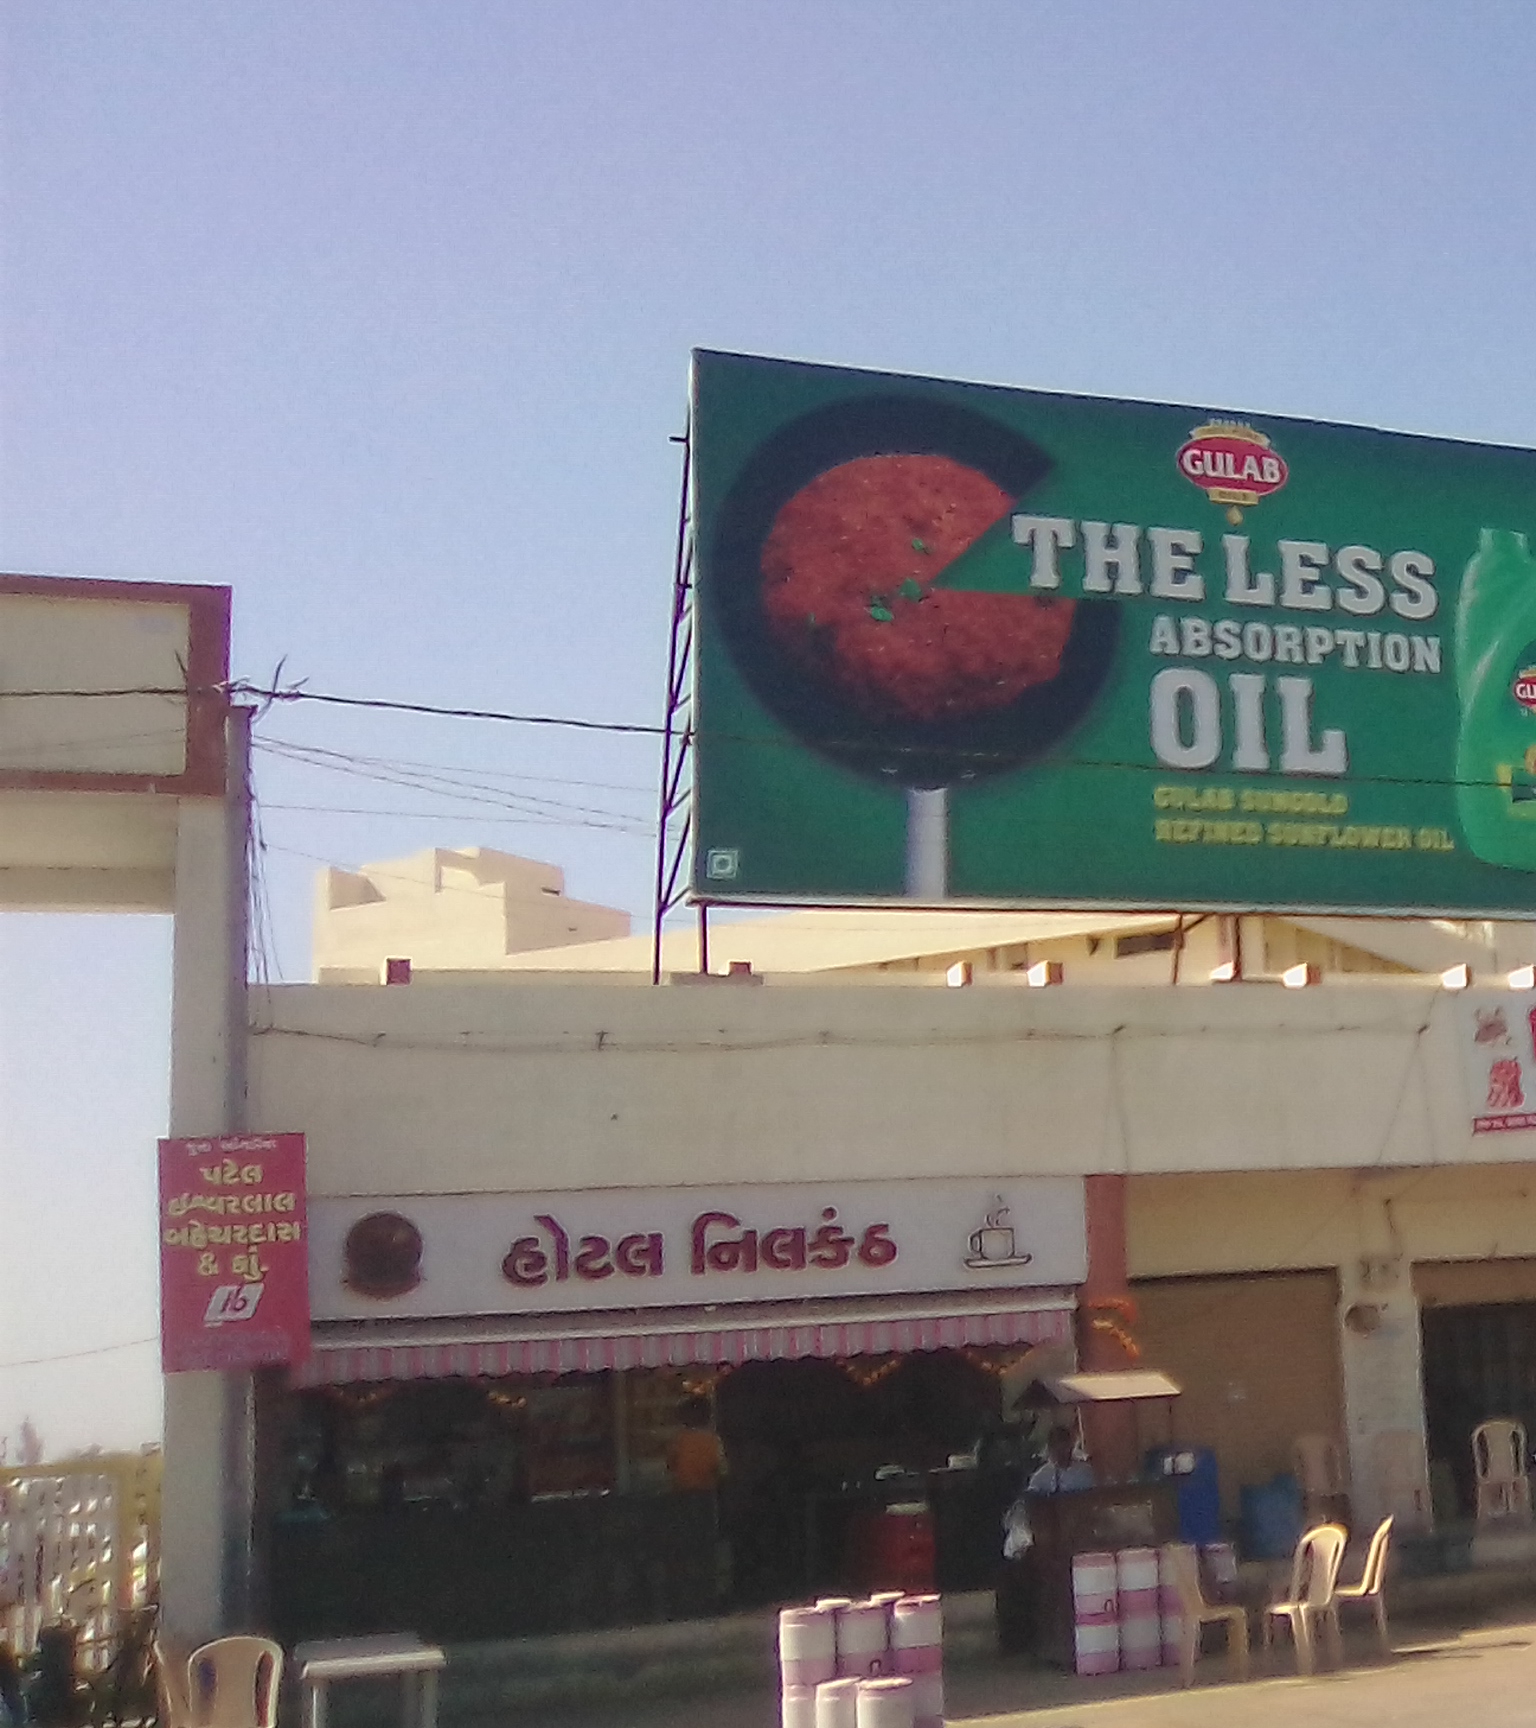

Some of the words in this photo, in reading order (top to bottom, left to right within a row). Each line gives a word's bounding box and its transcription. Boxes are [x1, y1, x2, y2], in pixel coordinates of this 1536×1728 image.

[1181, 448, 1281, 484] GULAB
[1010, 513, 1205, 600] THE
[1221, 532, 1439, 621] LESS
[1149, 613, 1441, 674] ABSORPTION
[1149, 666, 1349, 775] OIL
[1416, 826, 1456, 851] OIL
[199, 1157, 264, 1185] પટેલ
[501, 1213, 664, 1288] હોટલ
[690, 1206, 898, 1276] નિલકંઠ
